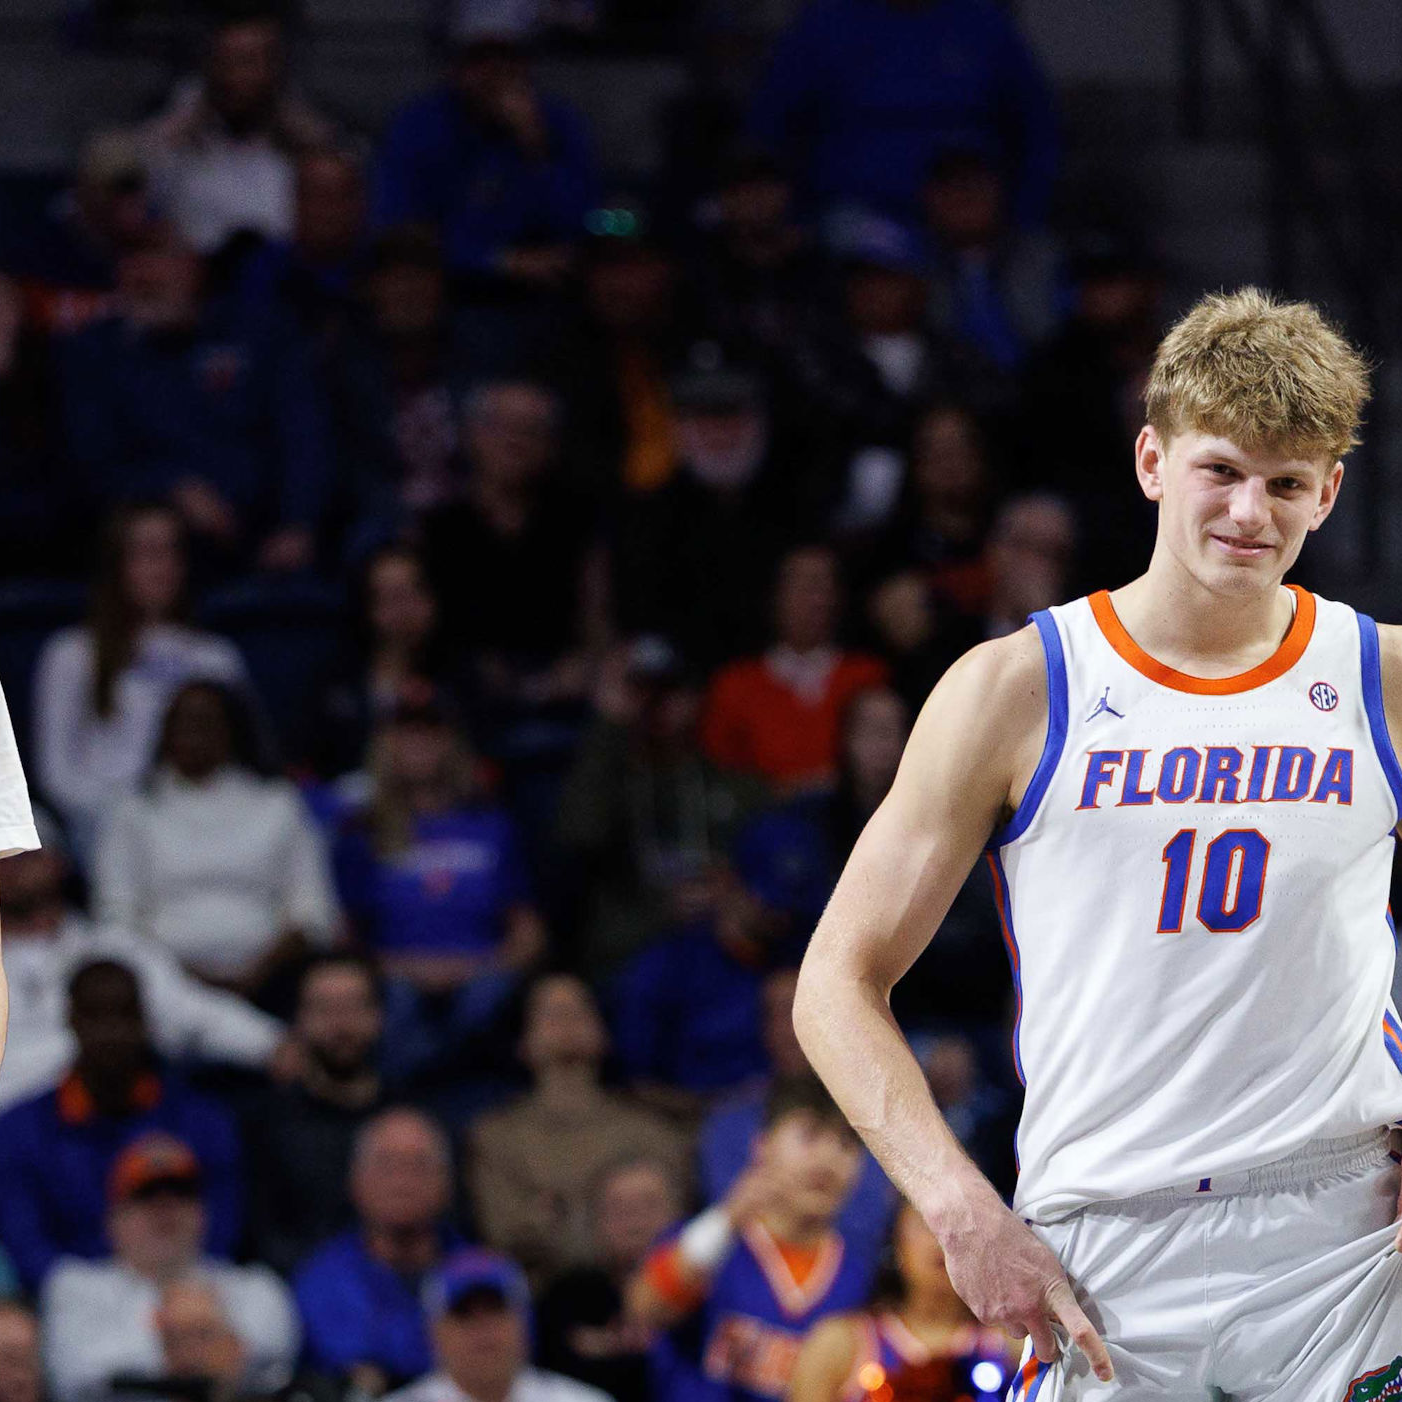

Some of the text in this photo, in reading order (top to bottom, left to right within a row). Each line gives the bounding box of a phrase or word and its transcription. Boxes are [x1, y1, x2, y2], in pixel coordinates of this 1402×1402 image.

[1310, 683, 1338, 711] SEC
[1074, 746, 1353, 811] FLORIDA
[1157, 828, 1271, 933] 10
